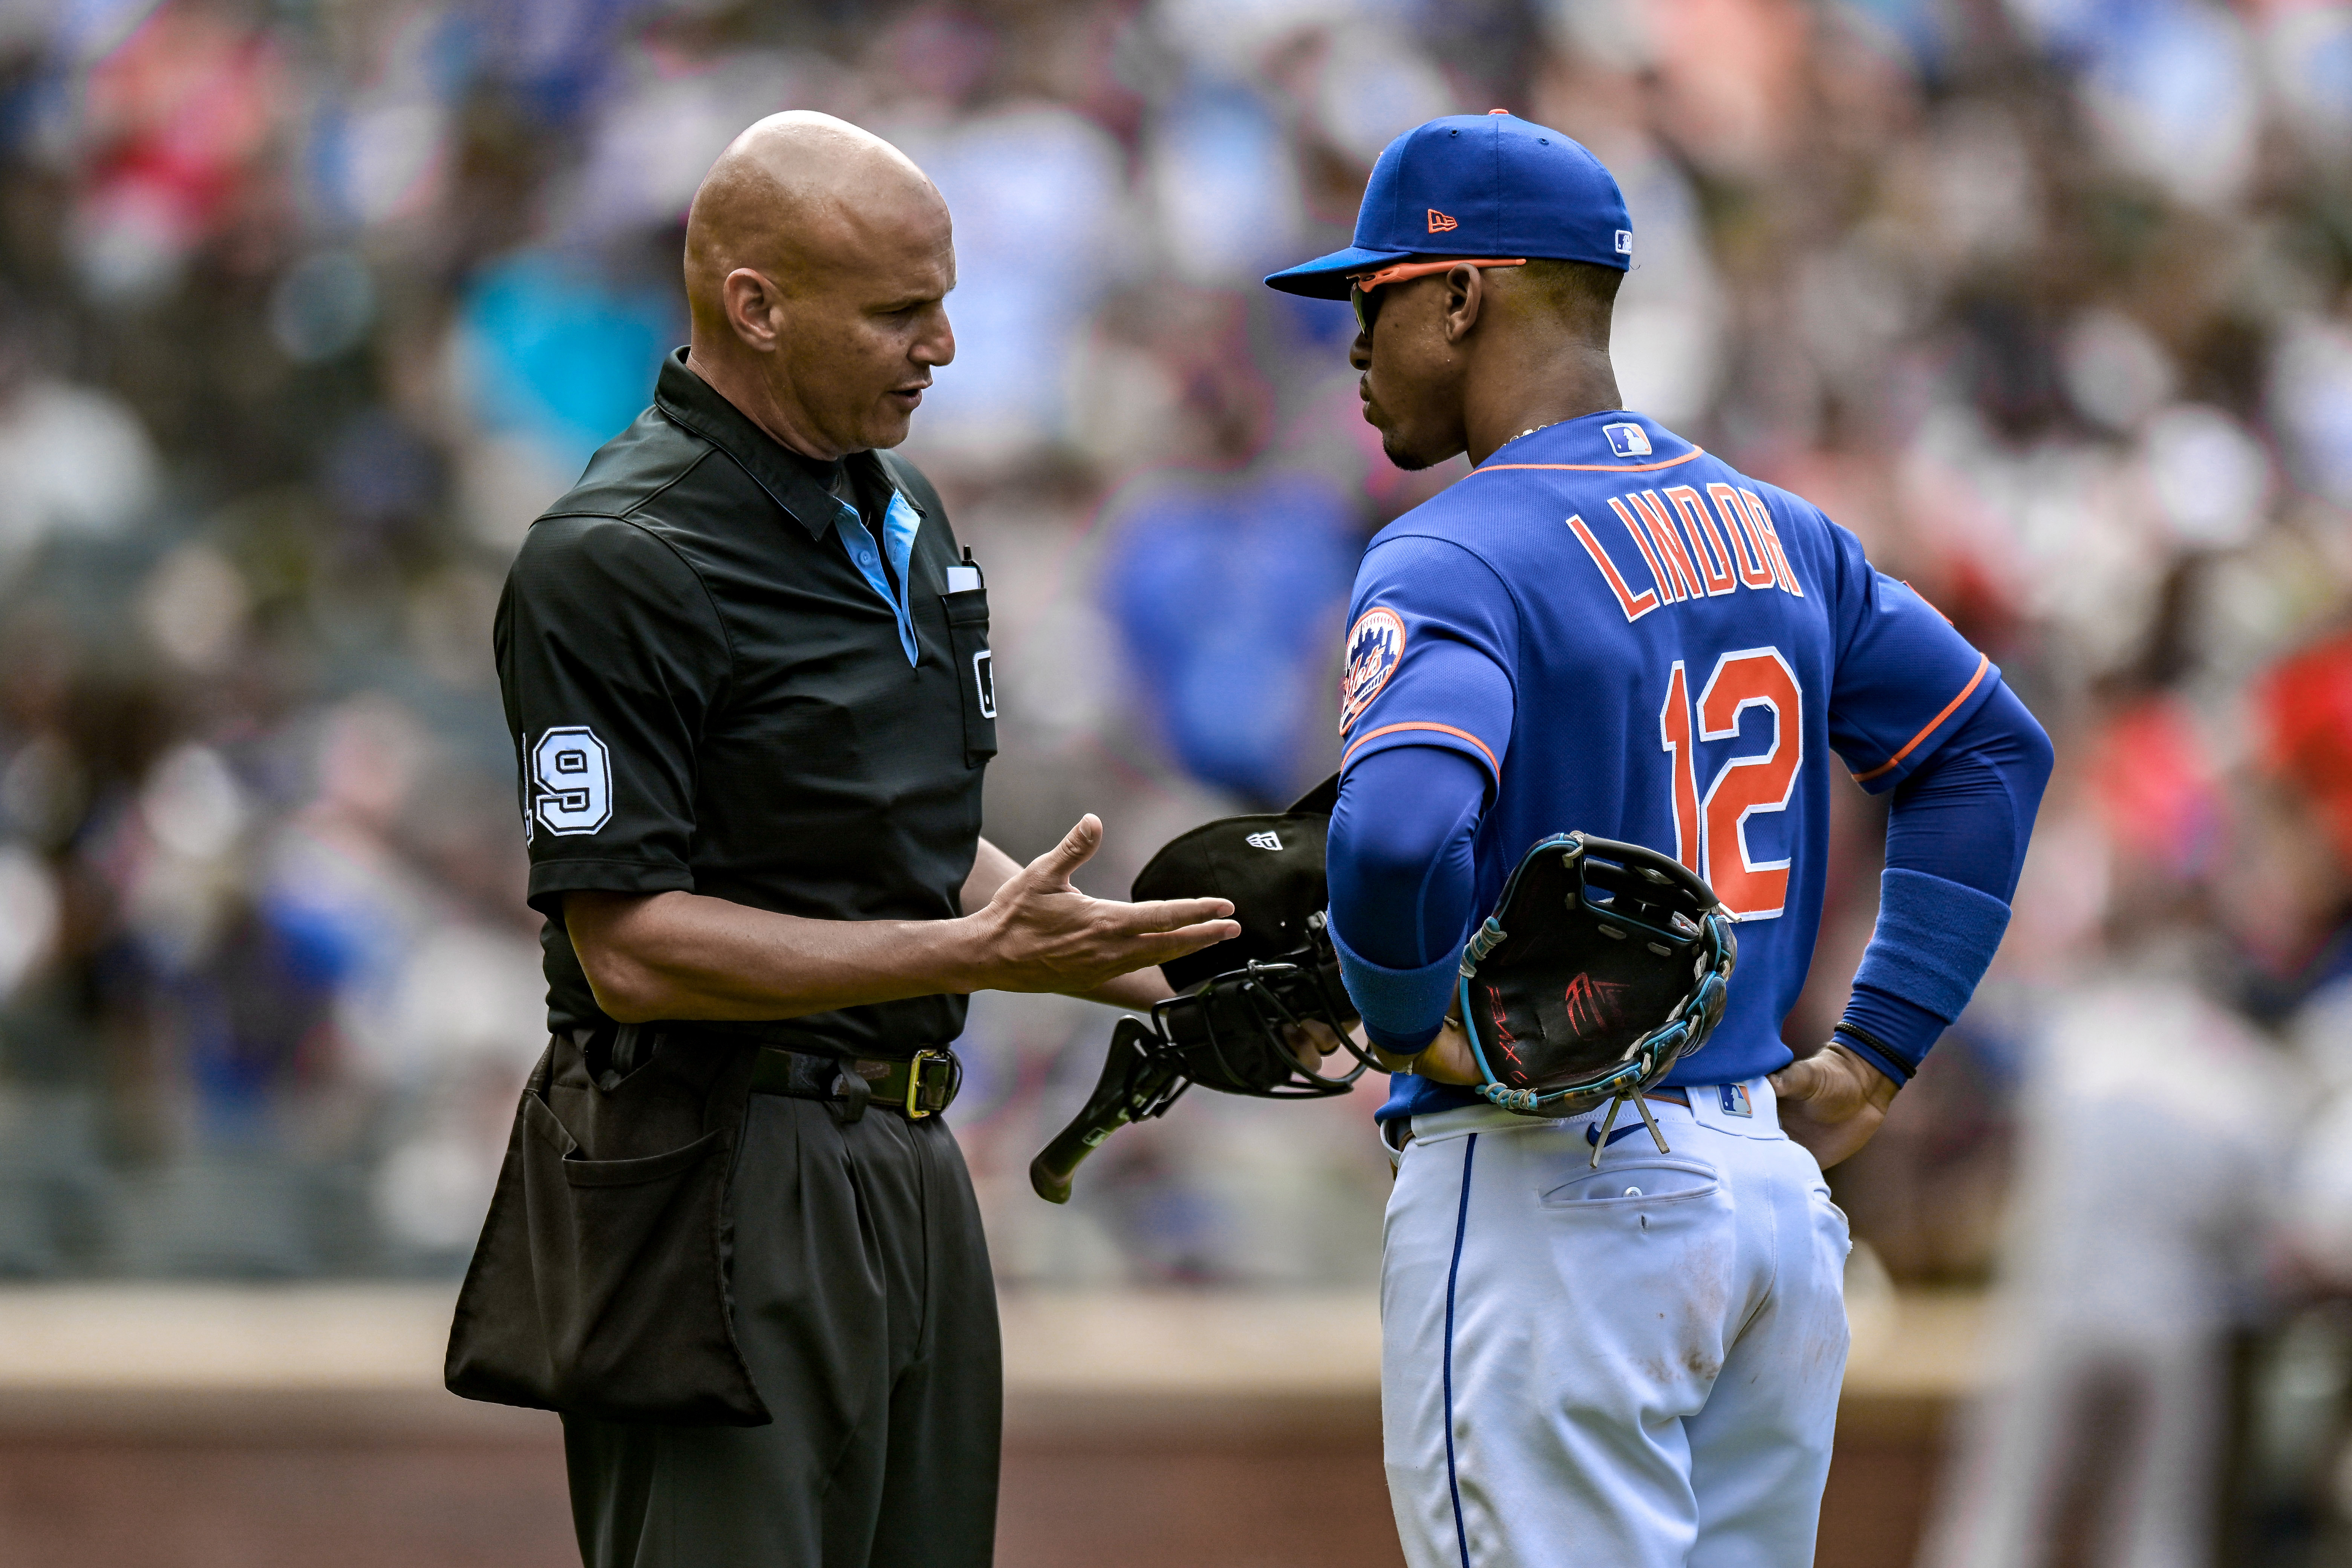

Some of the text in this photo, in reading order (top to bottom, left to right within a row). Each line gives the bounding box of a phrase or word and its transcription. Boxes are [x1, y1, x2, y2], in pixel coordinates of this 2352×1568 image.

[1566, 482, 1805, 623] LINDOR
[522, 726, 614, 848] 9
[1659, 645, 1804, 923] 12
